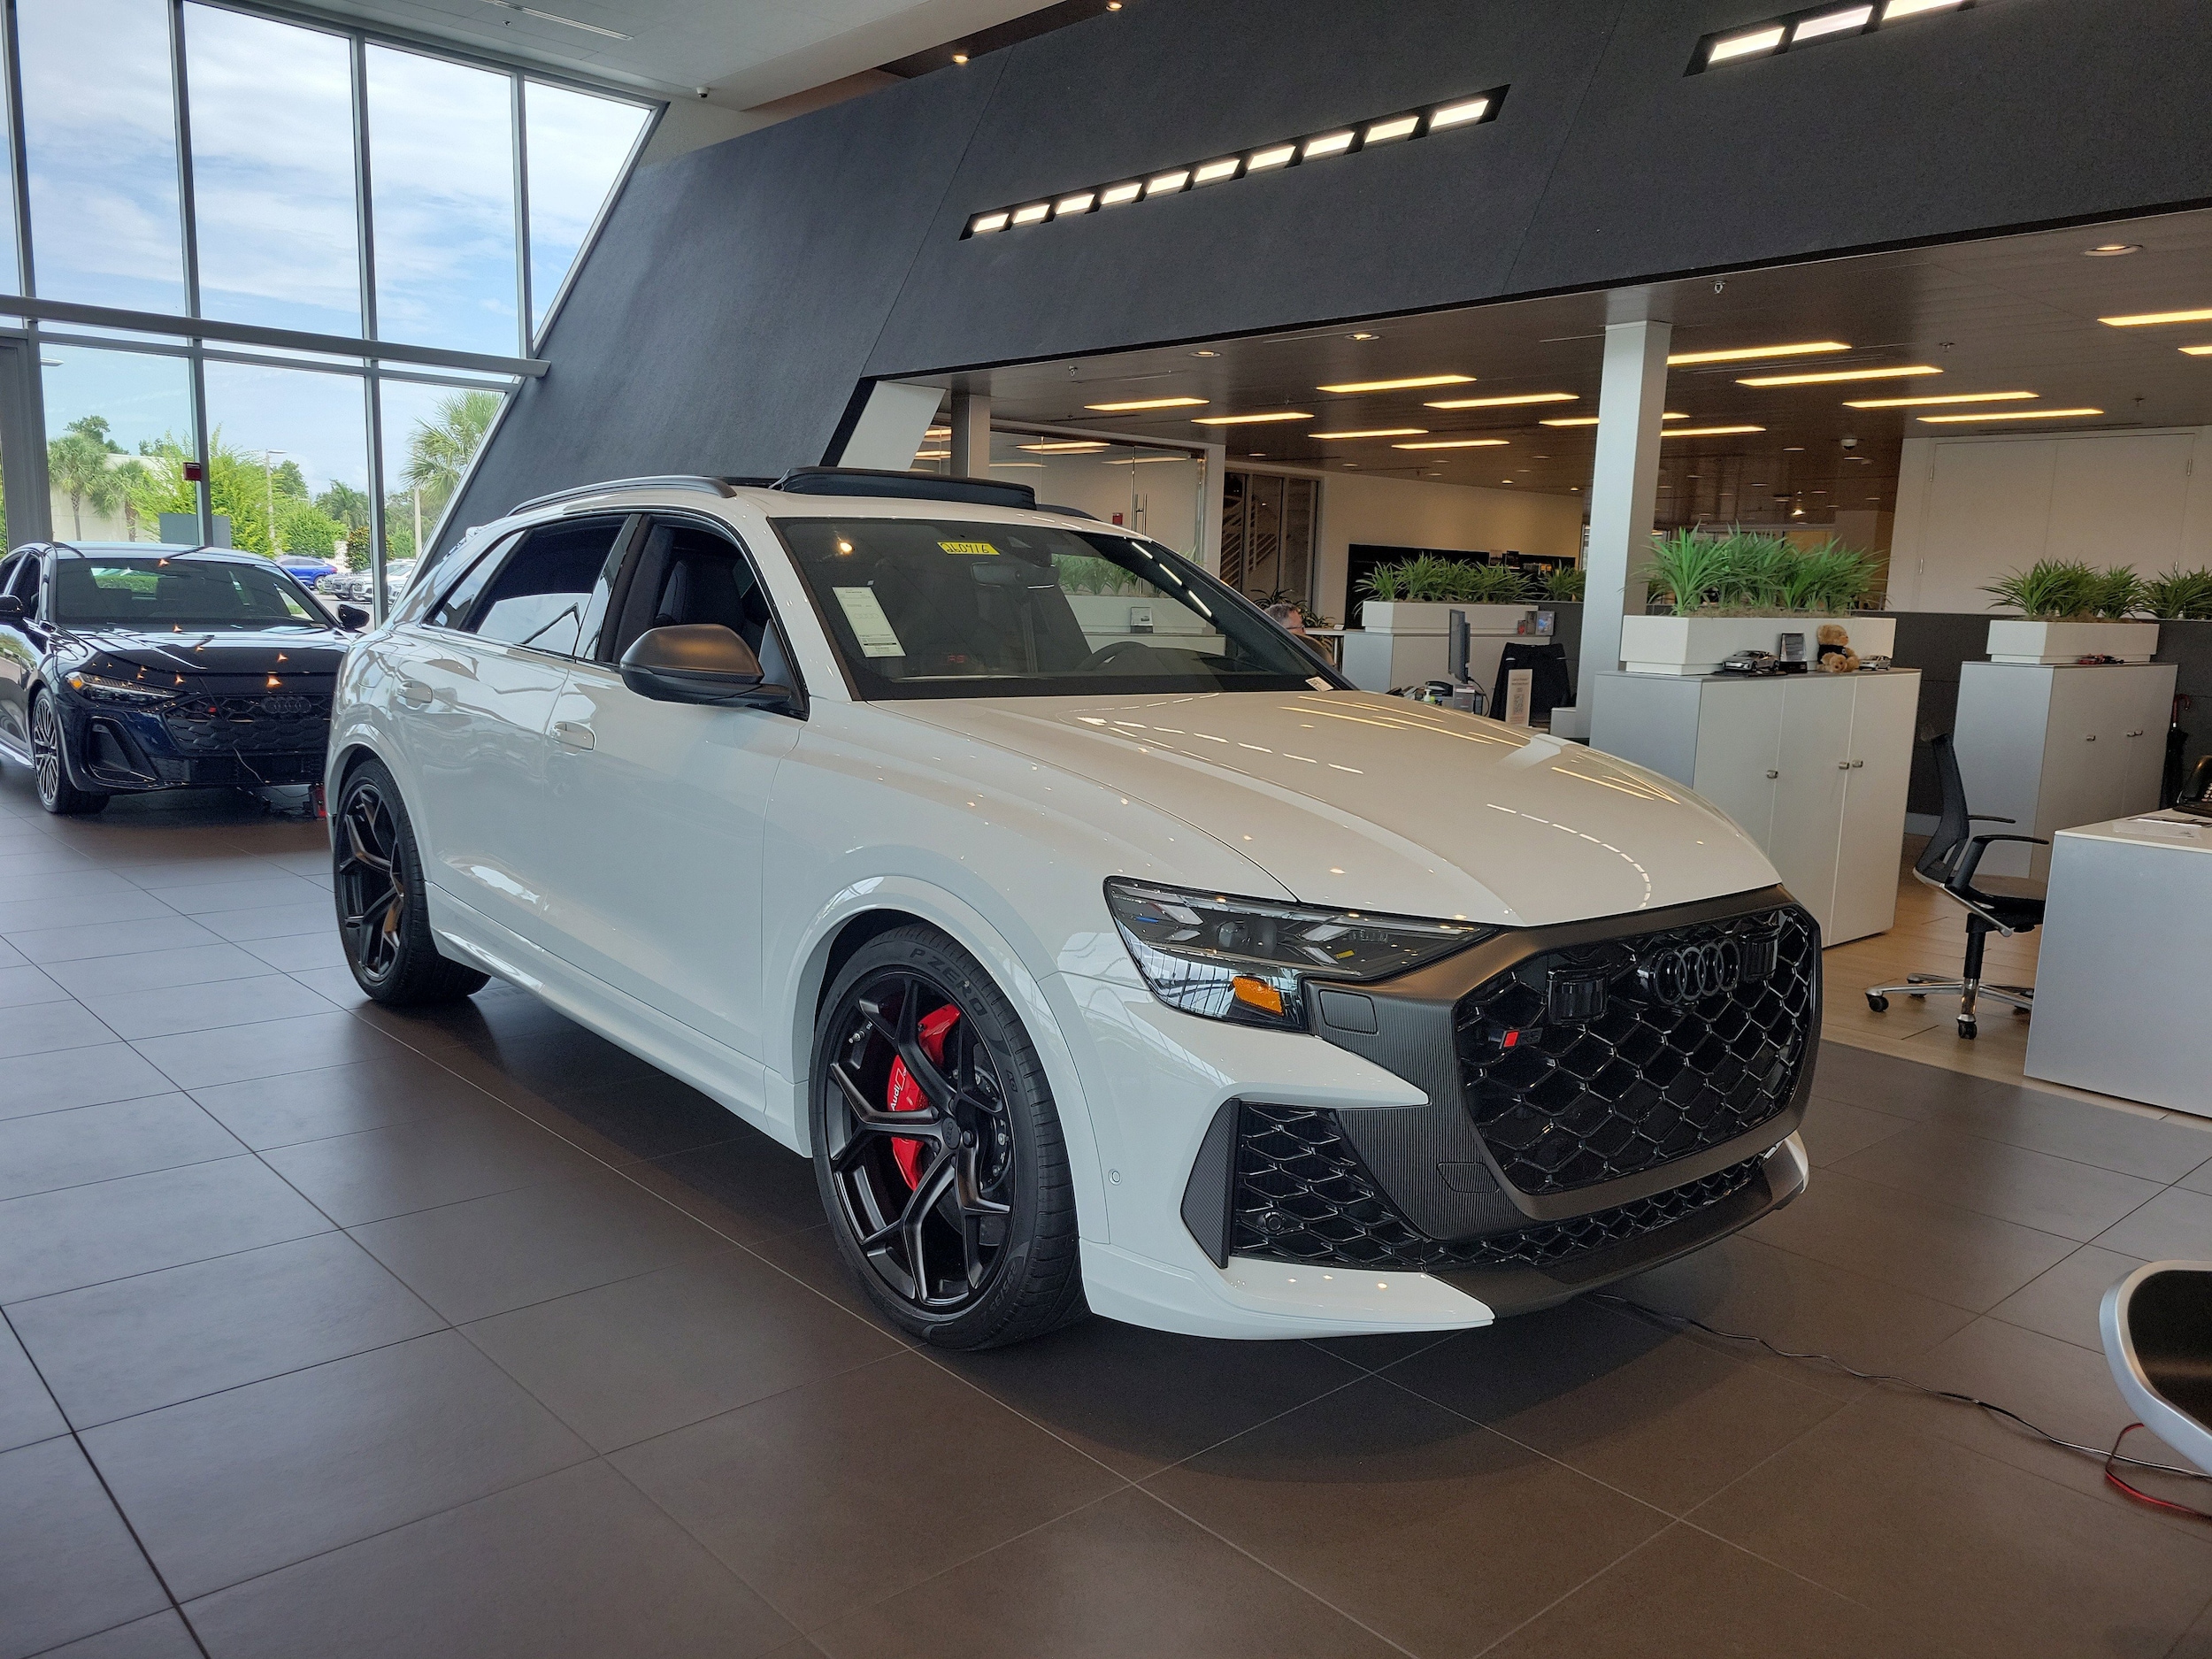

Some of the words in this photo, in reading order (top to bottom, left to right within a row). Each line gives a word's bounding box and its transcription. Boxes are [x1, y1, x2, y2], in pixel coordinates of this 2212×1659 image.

[910, 949, 926, 958] P
[927, 957, 988, 1016] ZERO
[890, 1085, 901, 1111] Audi
